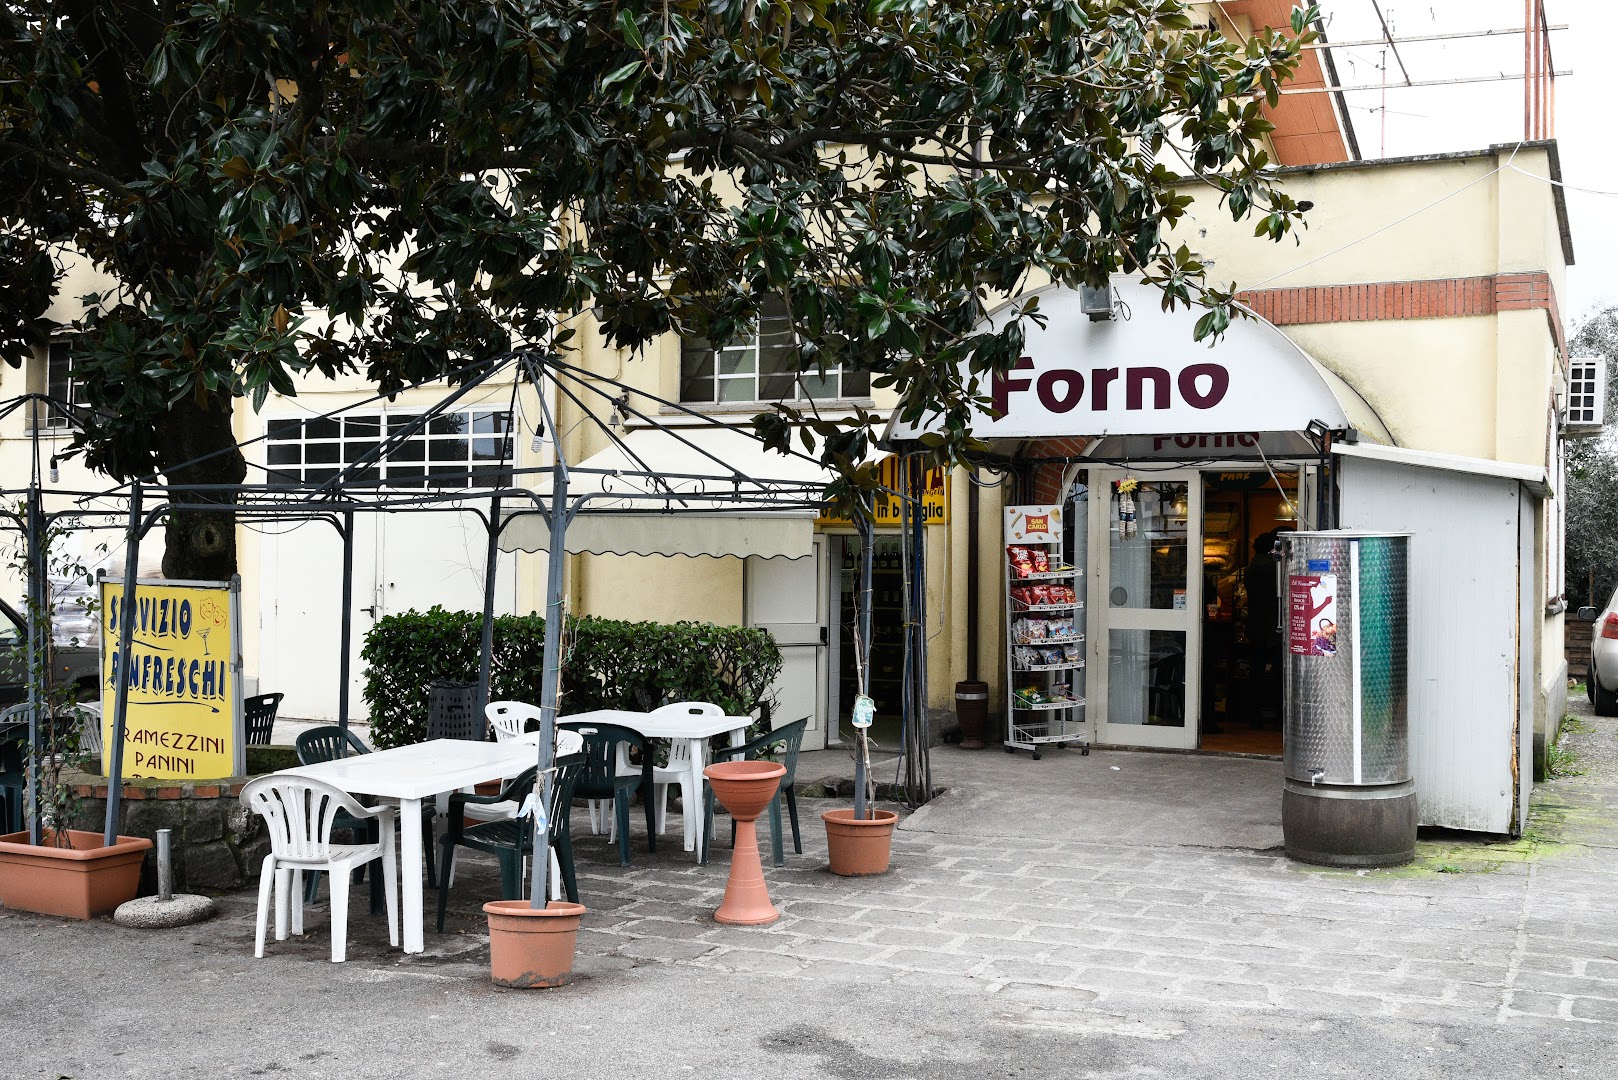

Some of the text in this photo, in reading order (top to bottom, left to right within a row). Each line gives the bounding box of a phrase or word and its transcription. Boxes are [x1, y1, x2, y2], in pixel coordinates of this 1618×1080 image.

[991, 356, 1230, 422] Forno
[110, 594, 192, 640] SVIZIO
[111, 651, 226, 702] RNFRESCHI
[110, 724, 224, 754] RAMEZZINI
[135, 751, 194, 774] PANINI
